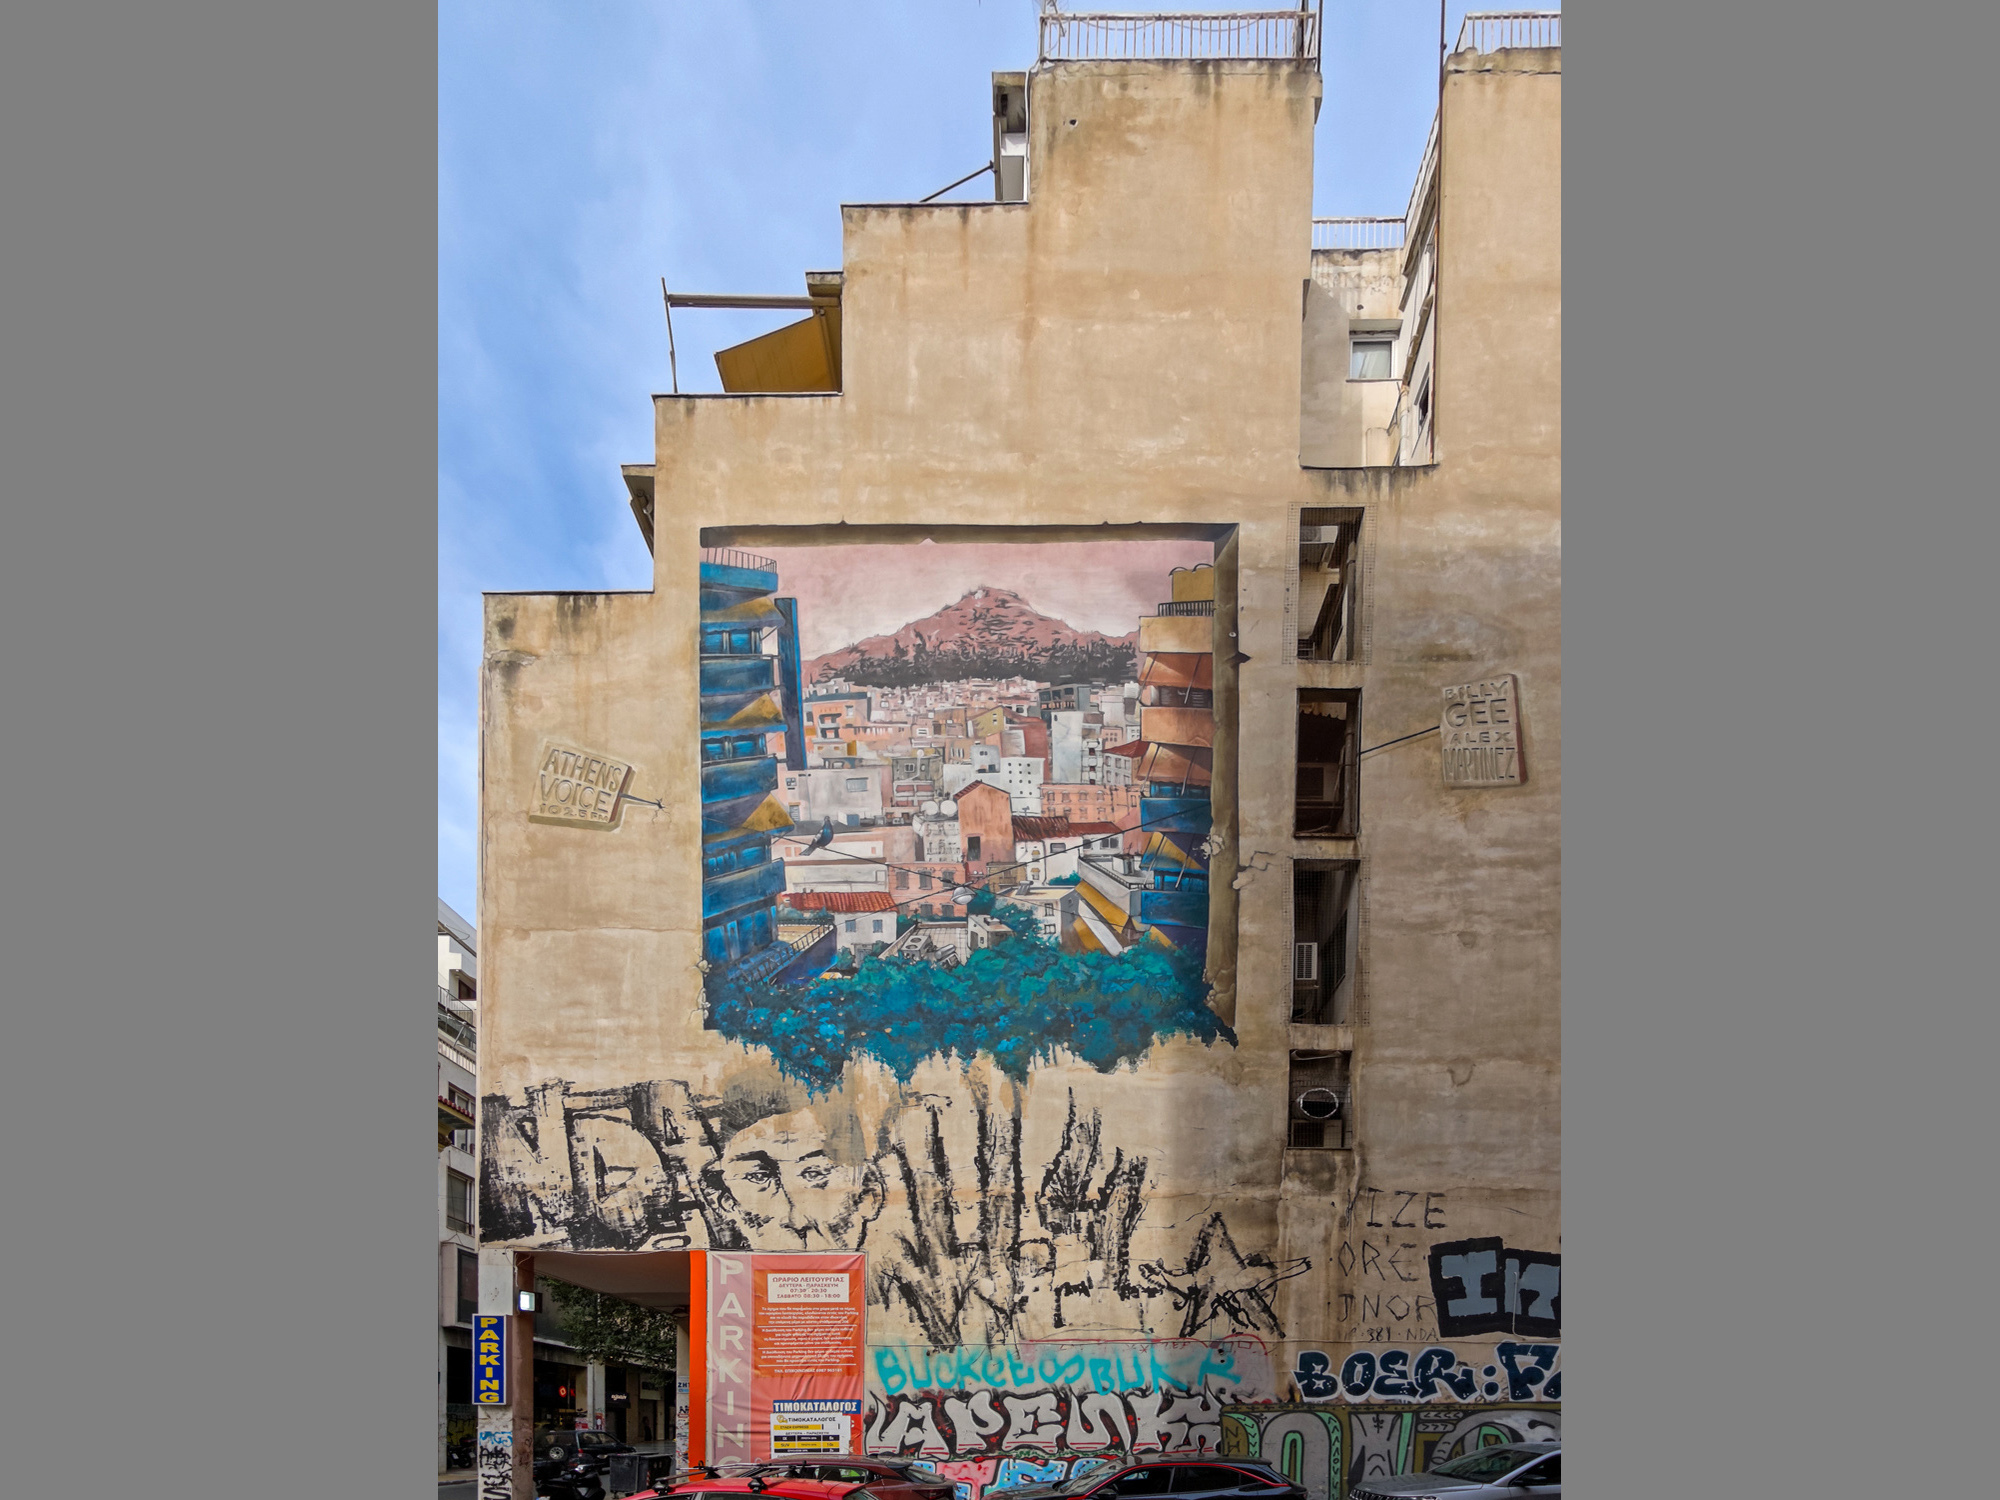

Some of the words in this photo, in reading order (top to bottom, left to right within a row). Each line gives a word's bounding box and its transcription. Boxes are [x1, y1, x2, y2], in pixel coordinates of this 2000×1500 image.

[1445, 681, 1508, 700] BILLY
[1445, 699, 1509, 728] GEE
[1451, 731, 1513, 744] ALEX
[542, 748, 622, 792] ATHENS
[1443, 747, 1515, 781] MARTINEZ
[540, 773, 612, 813] VOICE
[539, 803, 587, 818] 102.5
[590, 811, 609, 822] FM
[479, 1317, 500, 1403] PARKING
[773, 1401, 857, 1412] ΤΙΜΟΚΑΤΑΛΟΓΟΣ
